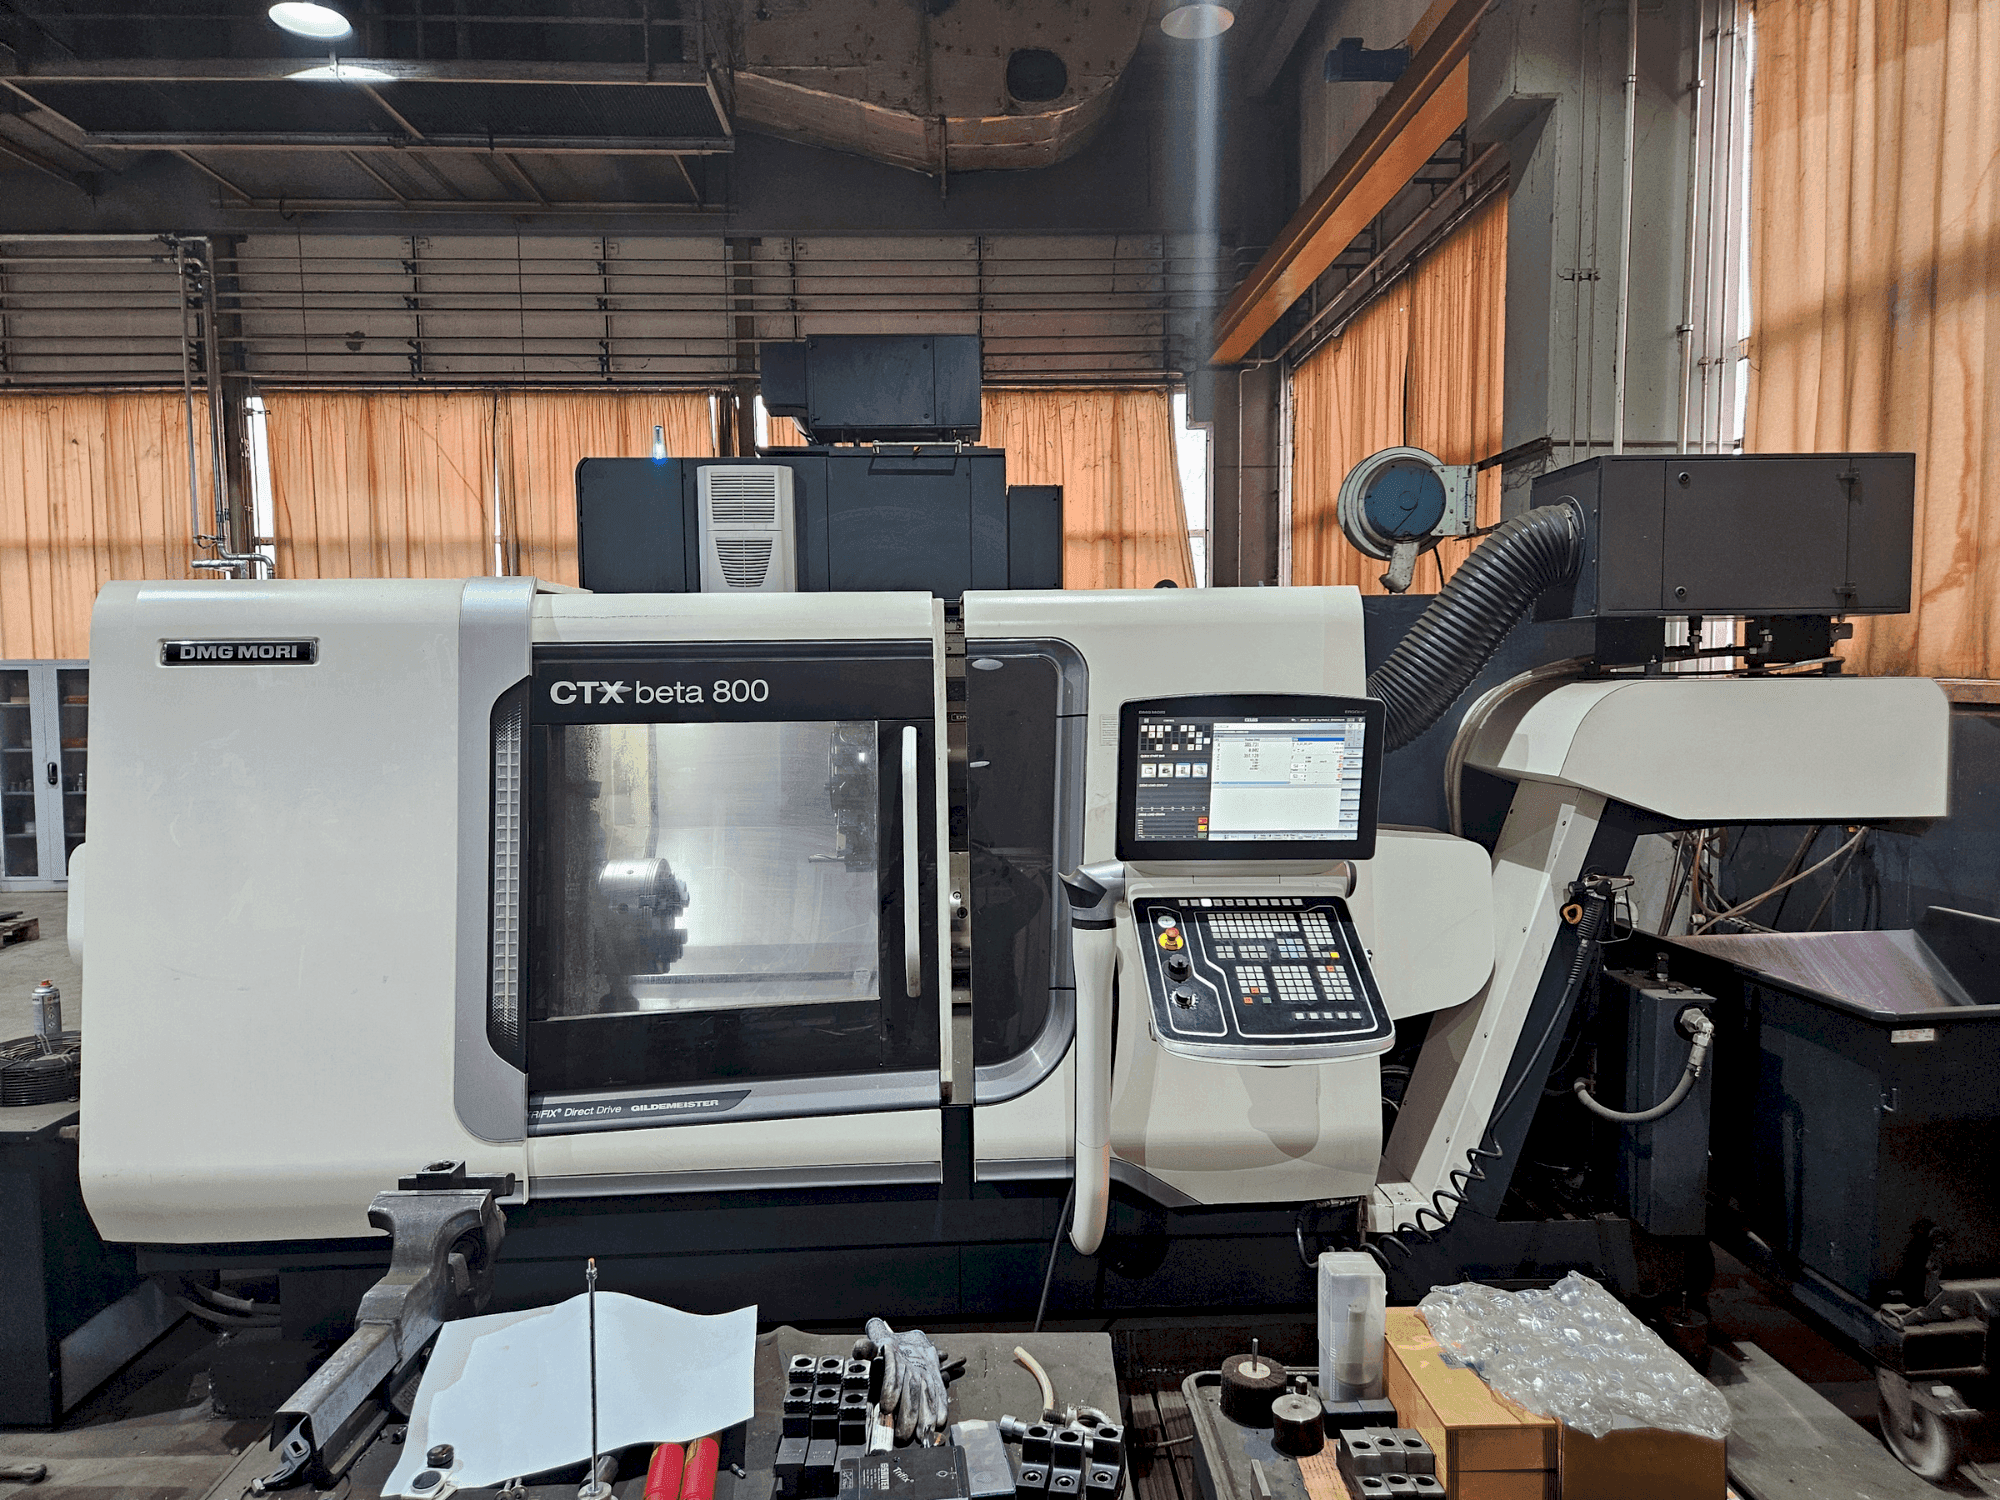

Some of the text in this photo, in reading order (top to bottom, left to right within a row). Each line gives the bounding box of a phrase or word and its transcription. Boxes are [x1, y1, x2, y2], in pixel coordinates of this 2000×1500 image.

[180, 645, 298, 660] DMG MORI
[550, 679, 769, 705] CTX beta 800
[564, 1106, 594, 1117] Direct
[596, 1104, 622, 1115] Drive
[630, 1099, 719, 1112] GILDEMEISTER
